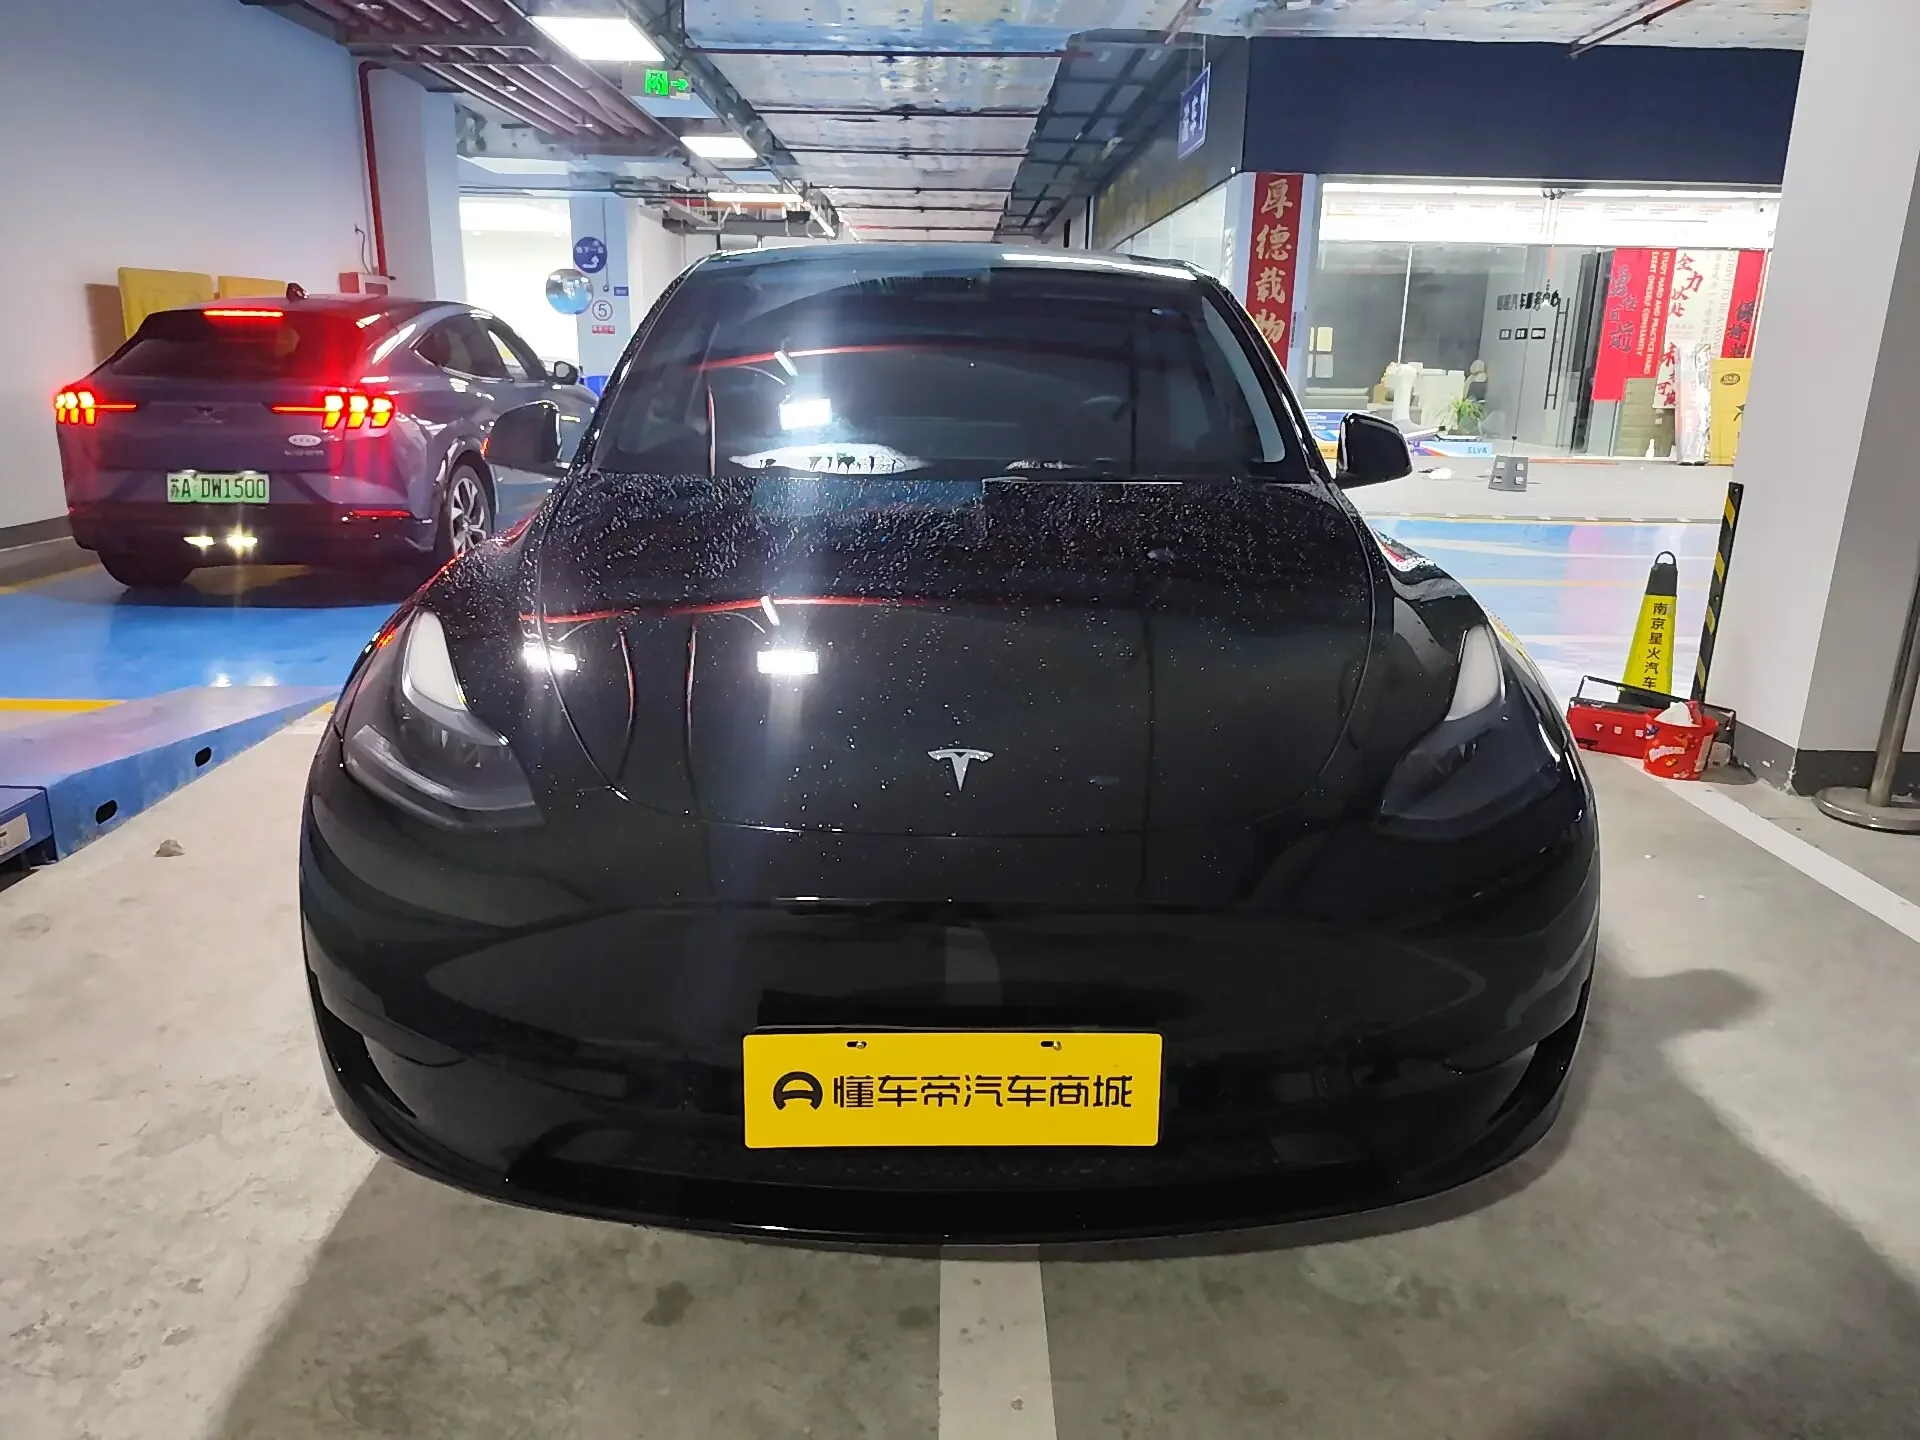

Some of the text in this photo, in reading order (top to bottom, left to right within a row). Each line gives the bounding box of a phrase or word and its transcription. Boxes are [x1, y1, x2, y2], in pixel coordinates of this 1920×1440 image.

[1256, 178, 1294, 344] 厚德载物
[598, 303, 608, 318] 5
[1653, 299, 1661, 317] AND
[201, 478, 266, 499] DW1500
[1642, 602, 1669, 689] 南京星火汽车
[833, 1074, 1133, 1108] 懂车帝汽车商城
